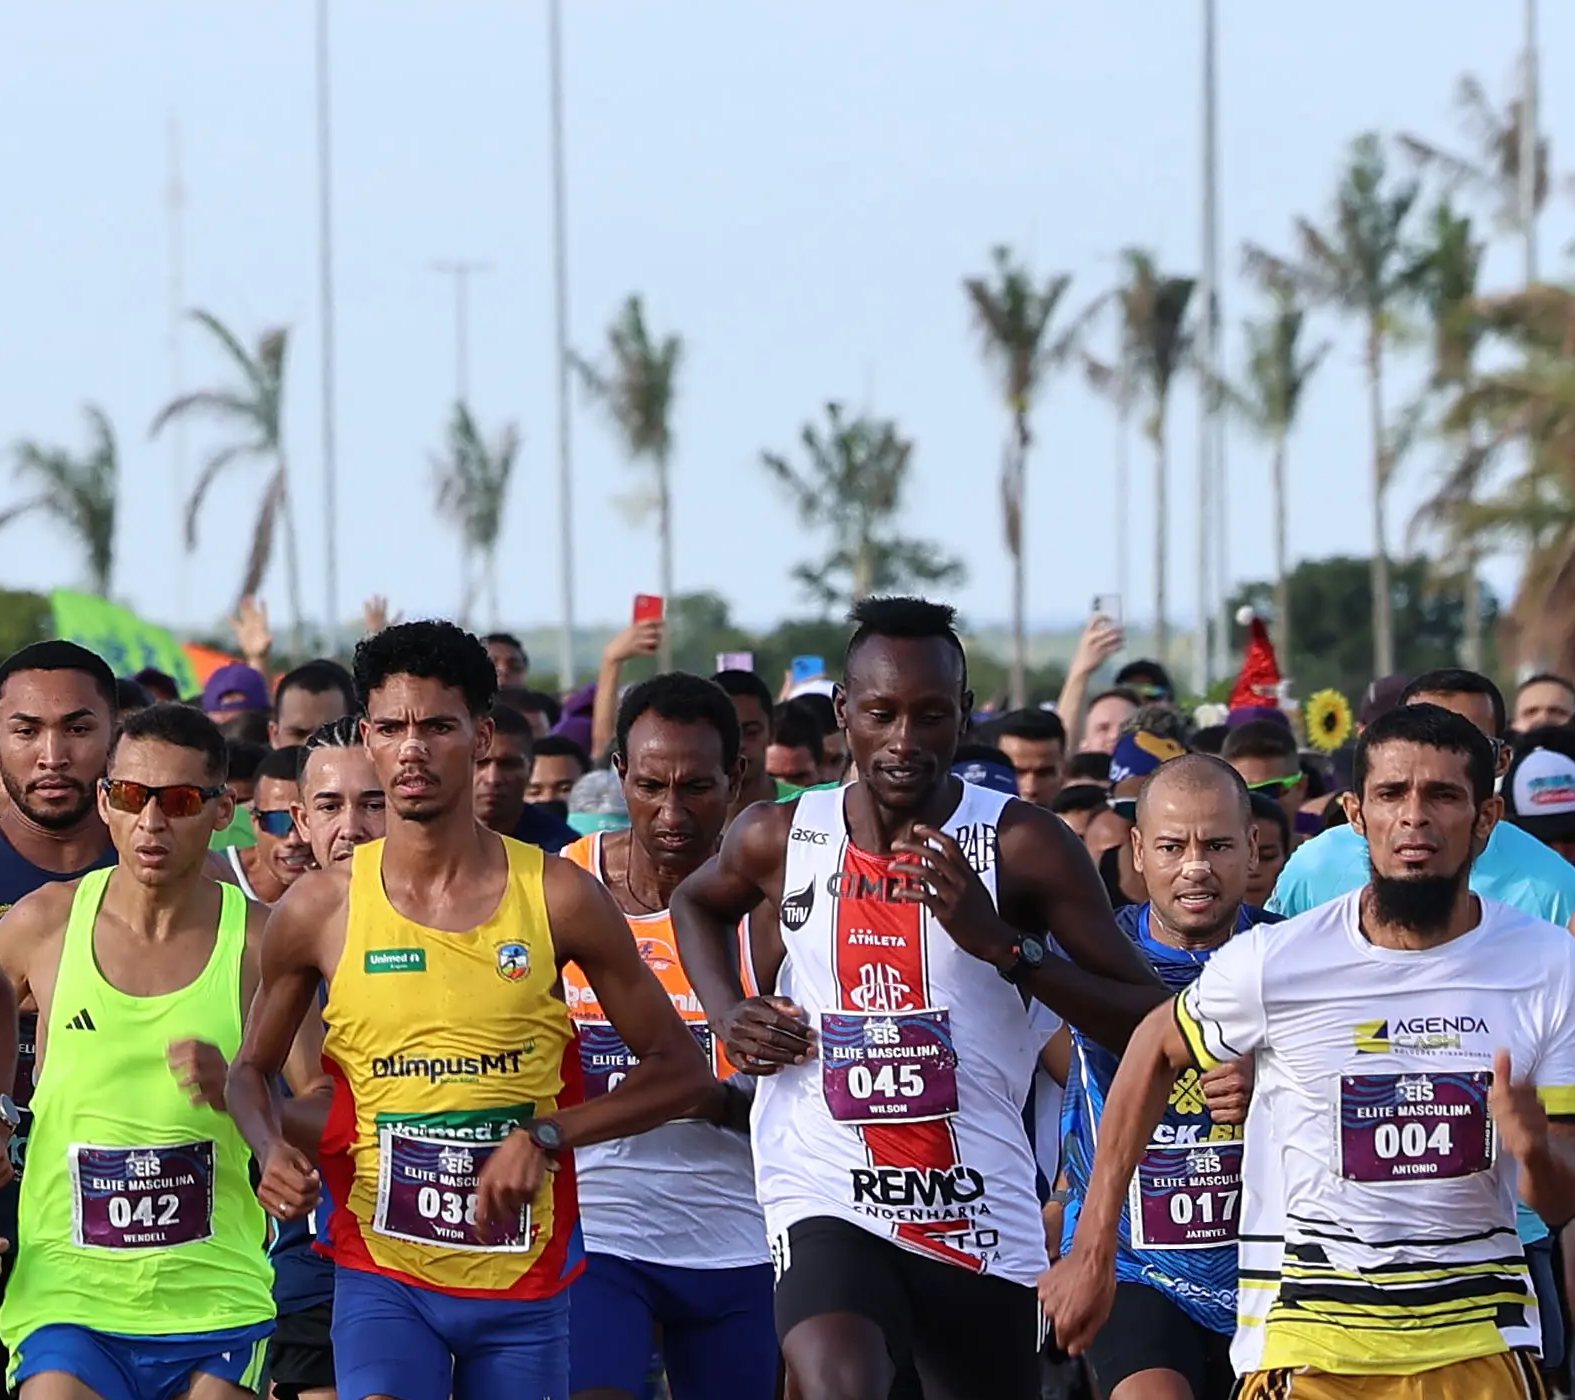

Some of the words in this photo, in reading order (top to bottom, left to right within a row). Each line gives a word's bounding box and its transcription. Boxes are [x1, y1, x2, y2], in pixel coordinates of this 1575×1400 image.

[791, 828, 830, 846] asics
[784, 906, 809, 923] THV
[848, 934, 906, 947] ATHLETA
[370, 953, 407, 964] Unimed
[1394, 1016, 1490, 1034] AGENDA
[593, 1055, 624, 1066] ELITE
[833, 1047, 863, 1060] ELITE
[867, 1044, 939, 1059] MASCULINA
[848, 1064, 925, 1099] 045
[870, 1104, 908, 1114] WILSON
[1357, 1106, 1394, 1119] ELITE
[1398, 1104, 1472, 1116] MASCULINA
[1374, 1122, 1453, 1159] 004
[405, 1166, 437, 1183] ELITE
[440, 1174, 481, 1188] MASCU
[1392, 1163, 1438, 1175] ANTONIO
[93, 1178, 125, 1191] ELITE
[129, 1174, 194, 1190] MASCULINA
[850, 1166, 985, 1207] REMO
[1153, 1177, 1186, 1188] ELITE
[1189, 1174, 1241, 1187] MASCULI
[109, 1194, 179, 1228] 042
[853, 1203, 991, 1220] ENGENHARIA
[1170, 1190, 1239, 1225] 017
[123, 1232, 166, 1243] WENDELL
[436, 1227, 464, 1240] VITOR
